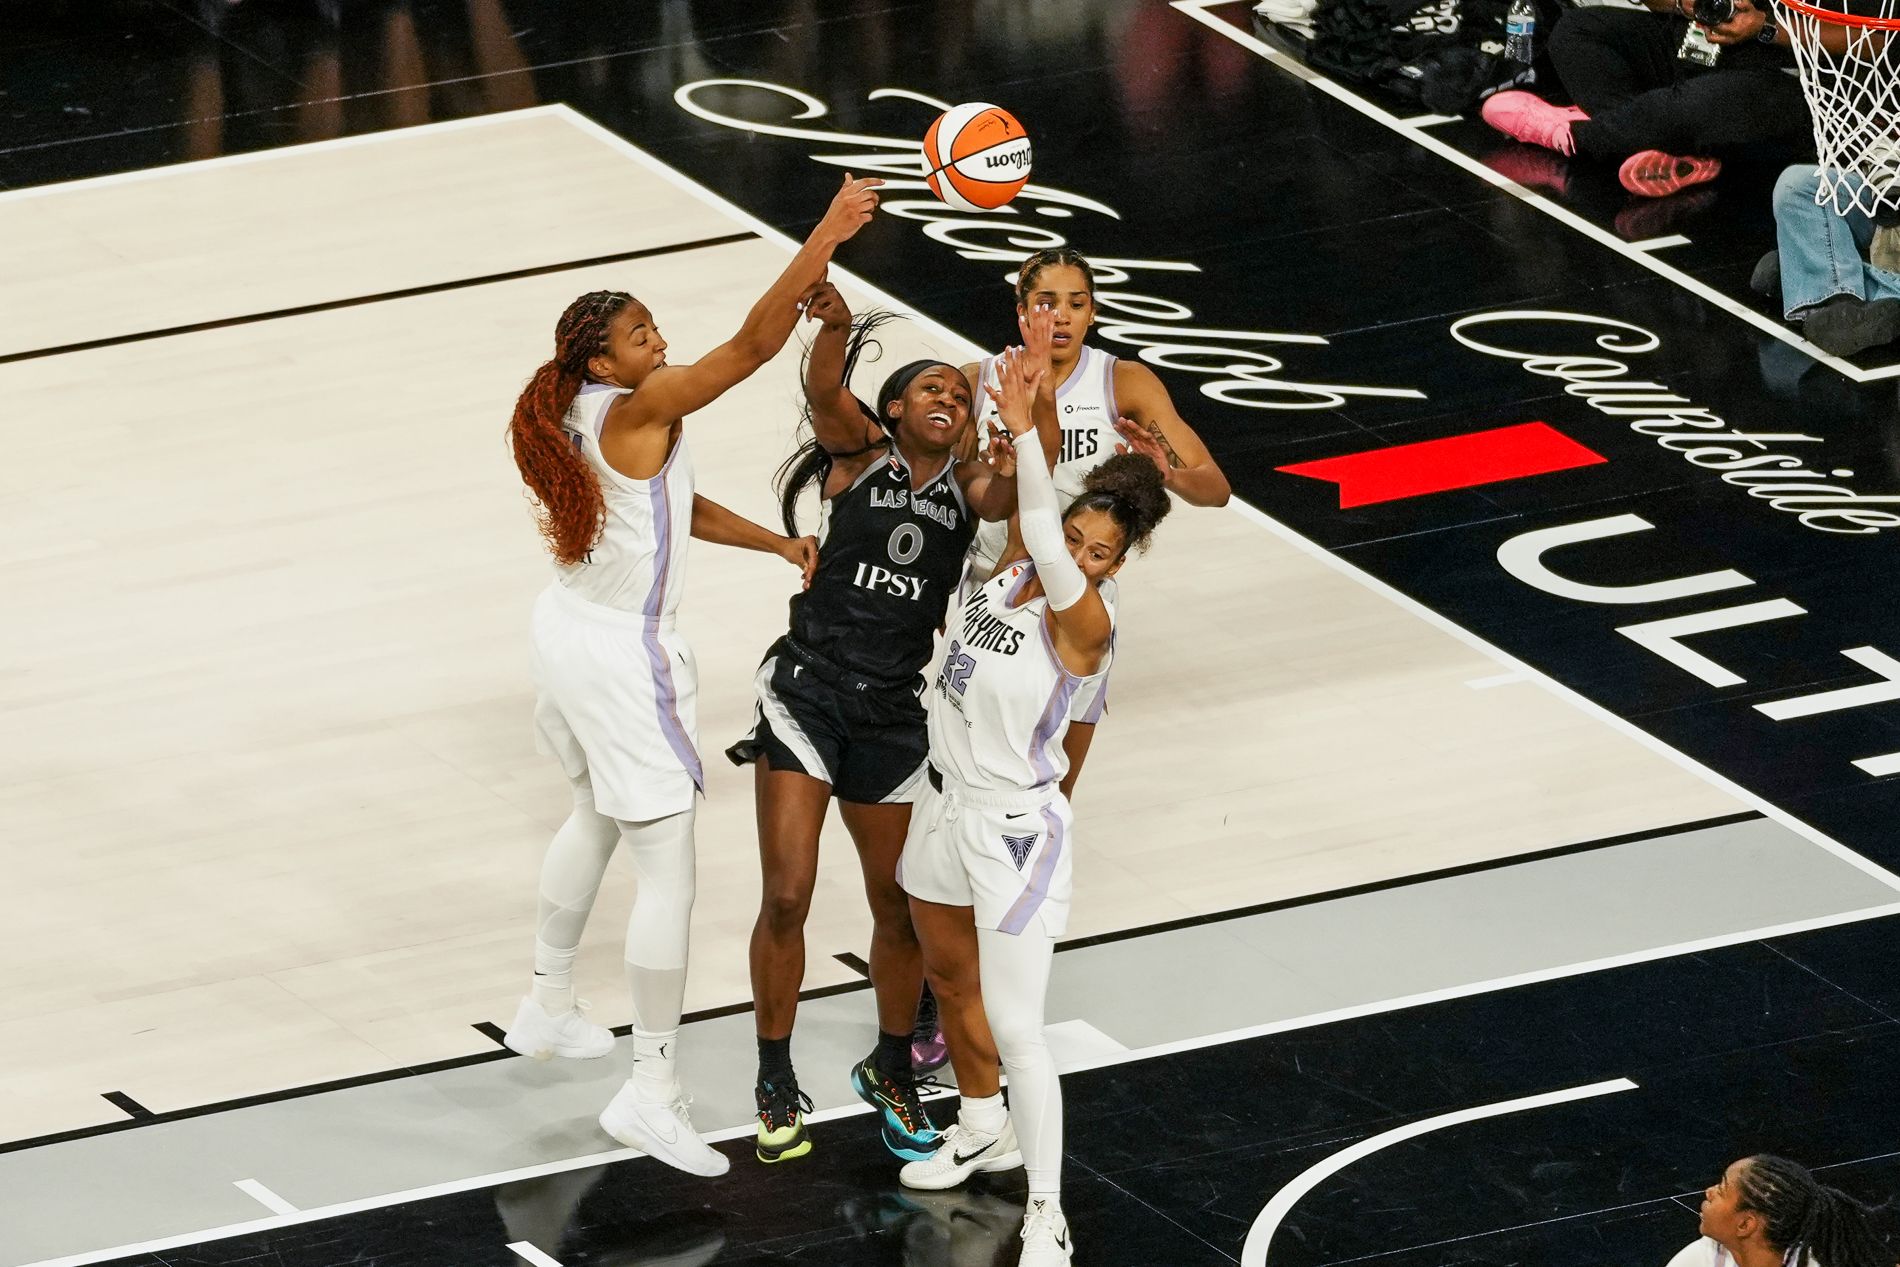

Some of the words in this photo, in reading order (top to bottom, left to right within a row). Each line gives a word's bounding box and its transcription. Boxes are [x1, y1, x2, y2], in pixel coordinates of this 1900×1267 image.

[674, 79, 1428, 409] Michelob
[1075, 404, 1100, 412] freedom
[1450, 310, 1900, 534] Courtside
[870, 486, 908, 509] LAS
[887, 522, 923, 565] 0
[853, 562, 928, 601] IPSY
[963, 586, 1026, 656] VAKYRIES
[1497, 513, 1900, 777] ULT
[942, 639, 977, 697] 22
